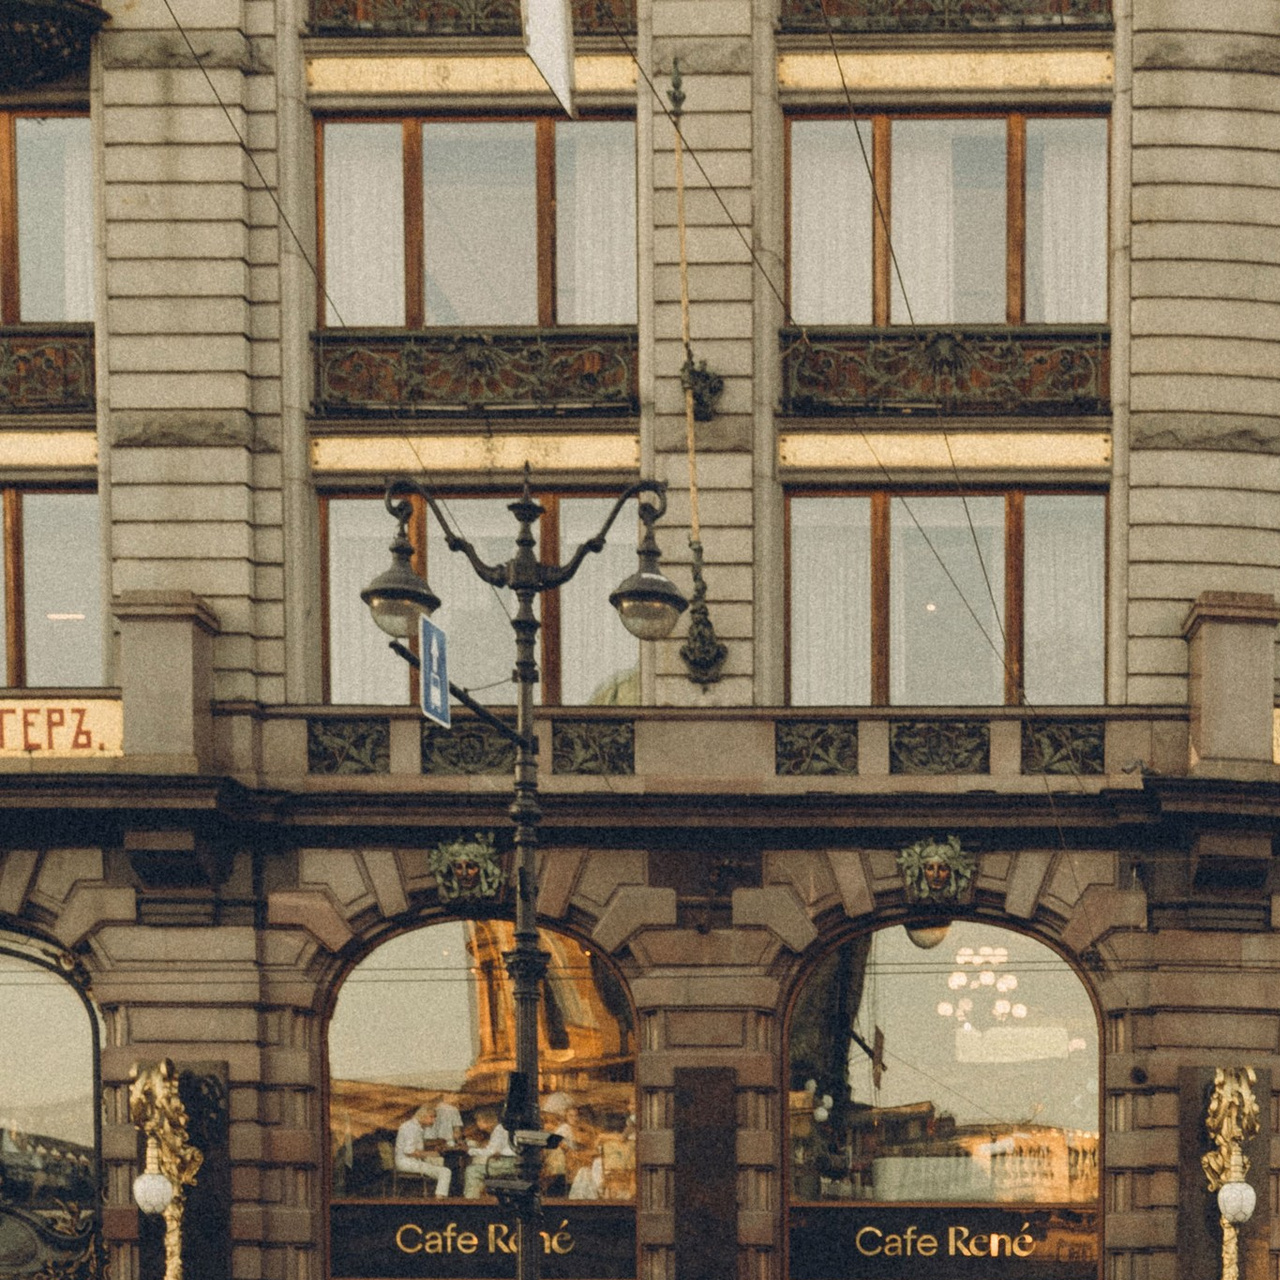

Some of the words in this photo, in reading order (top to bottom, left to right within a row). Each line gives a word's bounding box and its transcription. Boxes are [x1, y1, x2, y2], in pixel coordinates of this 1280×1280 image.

[395, 1222, 479, 1254] Cafe
[855, 1226, 938, 1256] Cafe
[948, 1222, 1036, 1257] René
